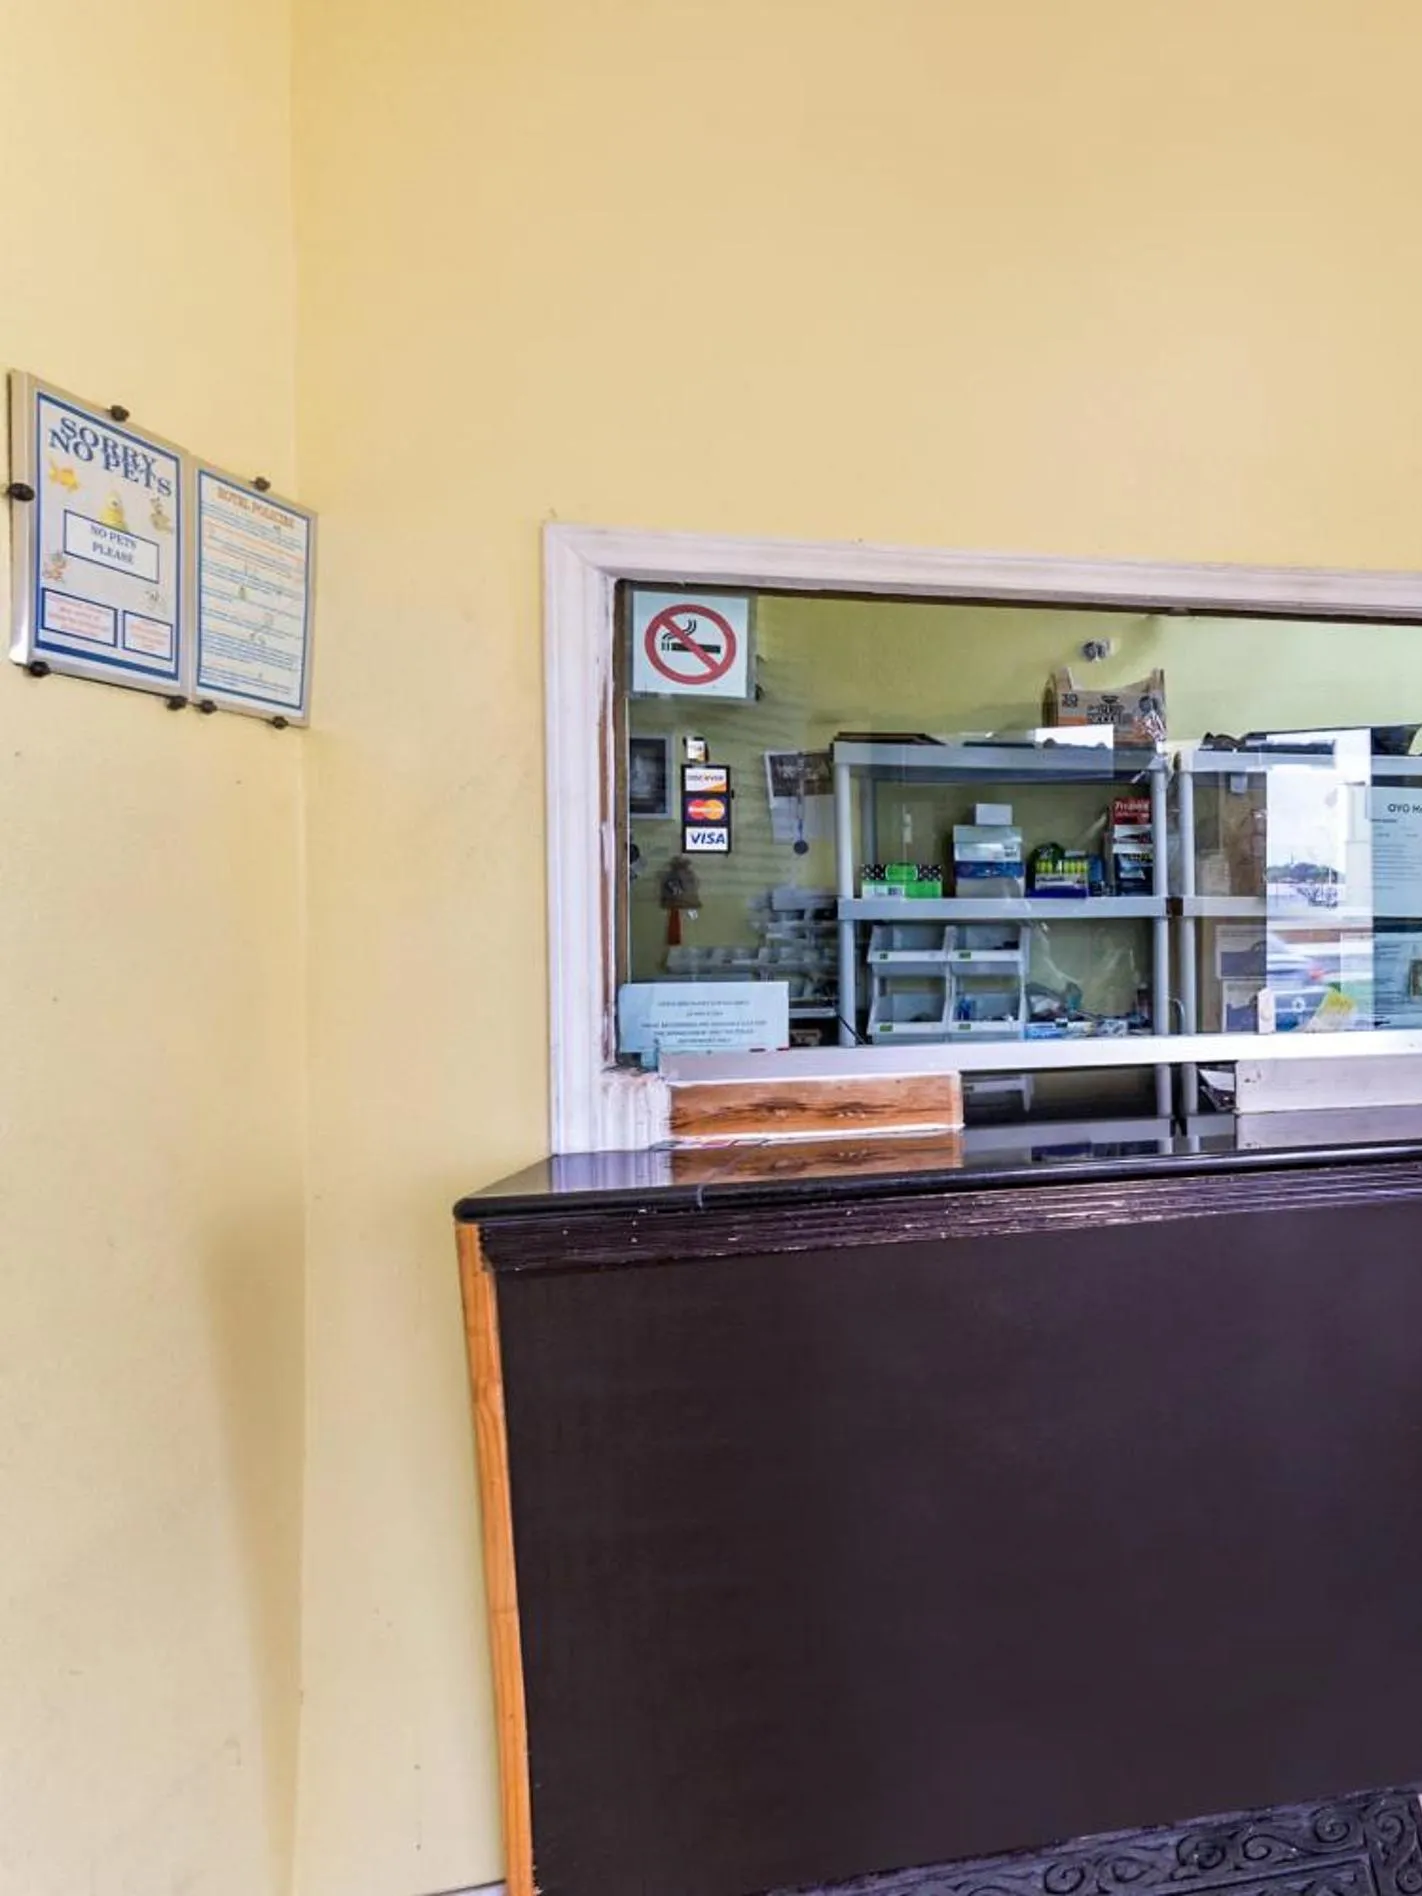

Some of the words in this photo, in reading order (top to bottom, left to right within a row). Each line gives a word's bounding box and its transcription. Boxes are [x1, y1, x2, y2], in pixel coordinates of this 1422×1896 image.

[60, 416, 156, 473] SORRY
[48, 427, 94, 462] NO
[102, 450, 172, 497] PETS
[90, 524, 107, 539] NO
[109, 532, 137, 550] PETS
[92, 541, 134, 565] PLEASE
[690, 832, 726, 845] VISA
